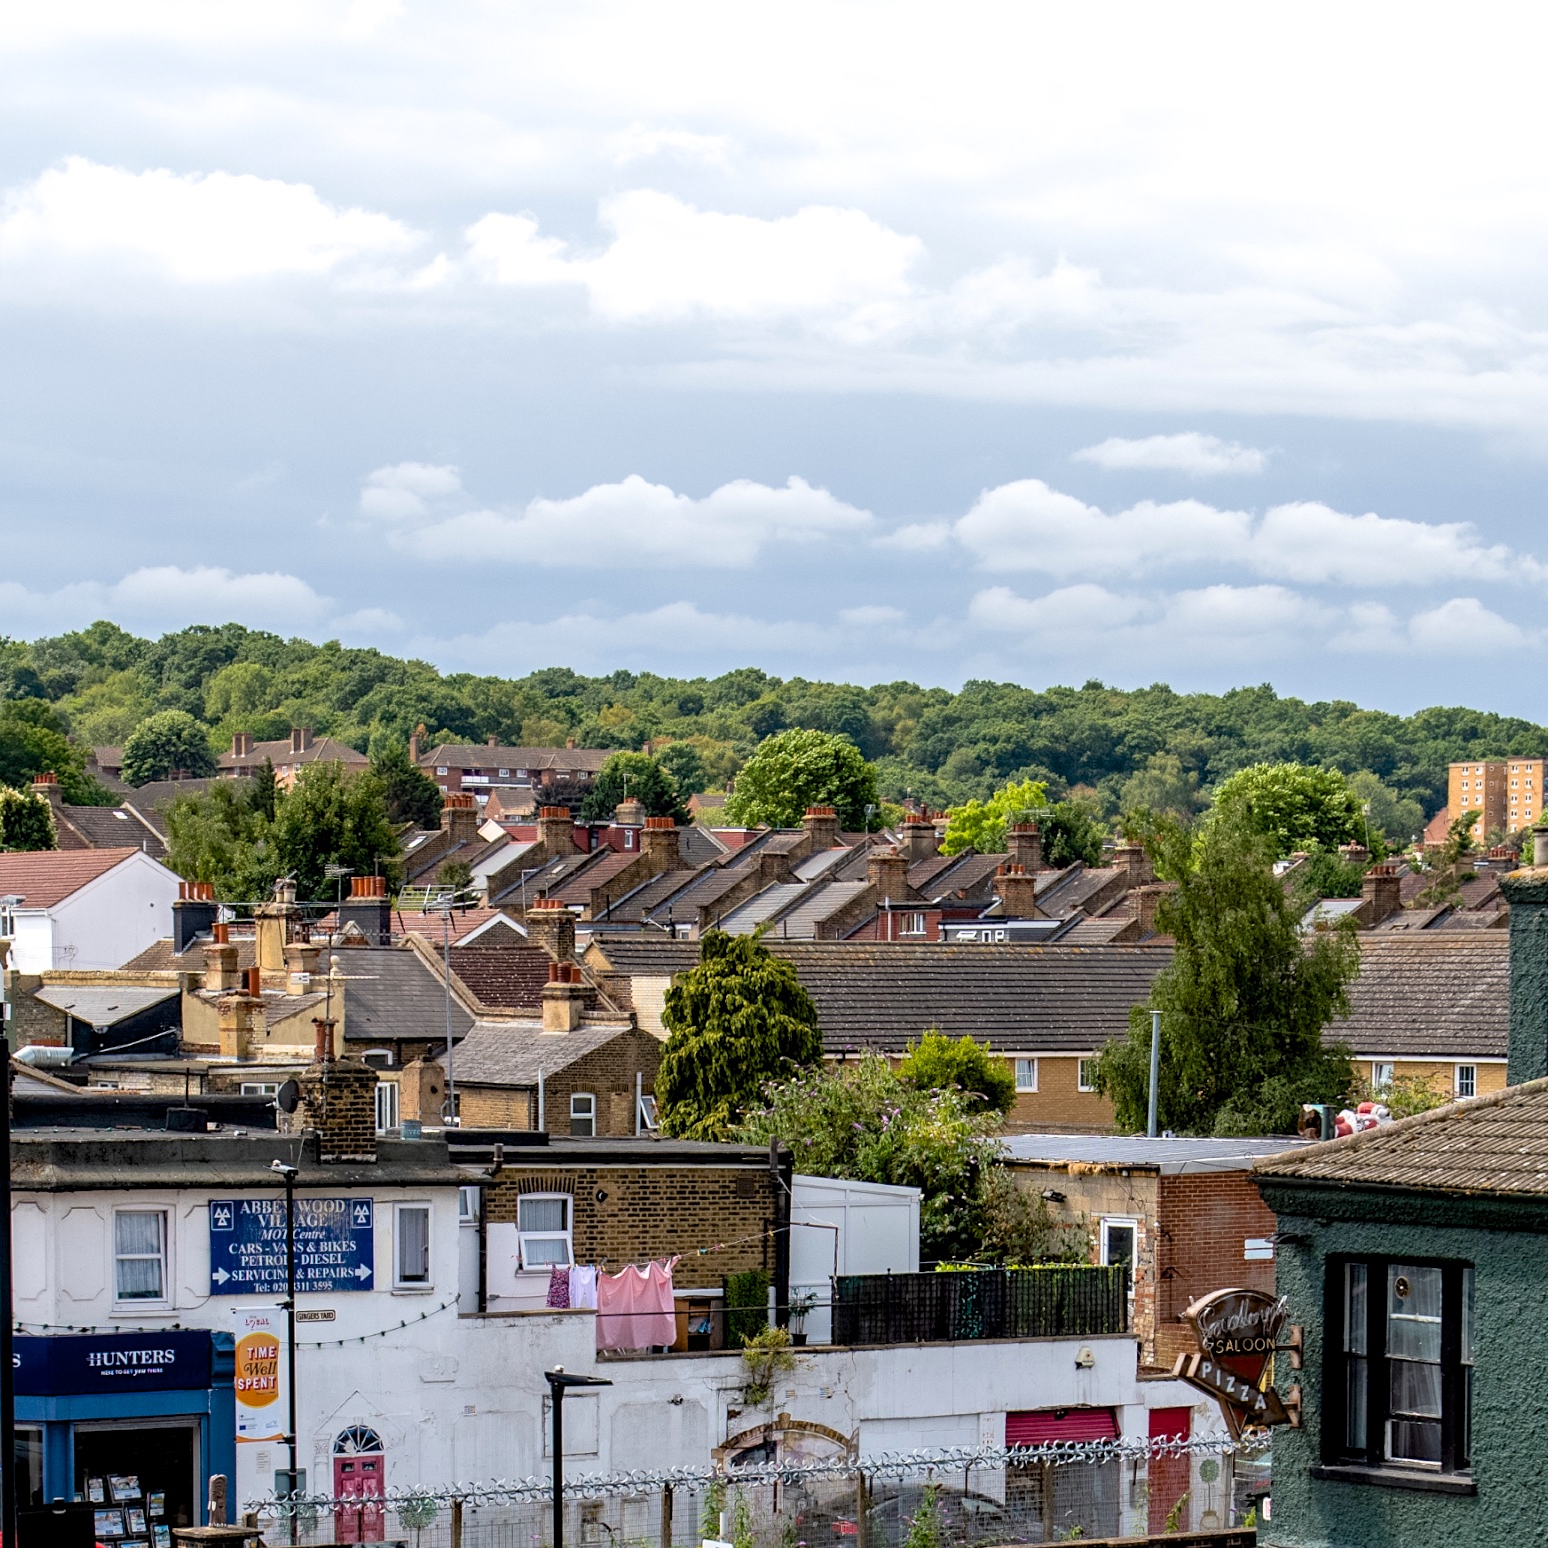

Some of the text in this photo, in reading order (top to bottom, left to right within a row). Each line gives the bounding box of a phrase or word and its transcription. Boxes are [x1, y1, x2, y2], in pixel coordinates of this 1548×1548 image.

[296, 1199, 346, 1214] WOOD
[258, 1213, 328, 1228] VILAGE
[293, 1229, 326, 1240] Centre
[228, 1243, 263, 1254] CARS
[306, 1241, 316, 1253] &
[319, 1240, 357, 1252] BIKES
[301, 1253, 346, 1265] DIESEL
[296, 1268, 305, 1280] &
[307, 1267, 355, 1279] REPAIRS
[253, 1282, 272, 1293] Tel:
[313, 1280, 333, 1290] 3595
[1215, 1337, 1276, 1354] SALOON
[86, 1348, 175, 1367] HUNTERS
[247, 1346, 277, 1361] TIME
[243, 1360, 277, 1377] Well
[237, 1376, 276, 1391] SPENT
[1201, 1361, 1267, 1411] PIZZA
